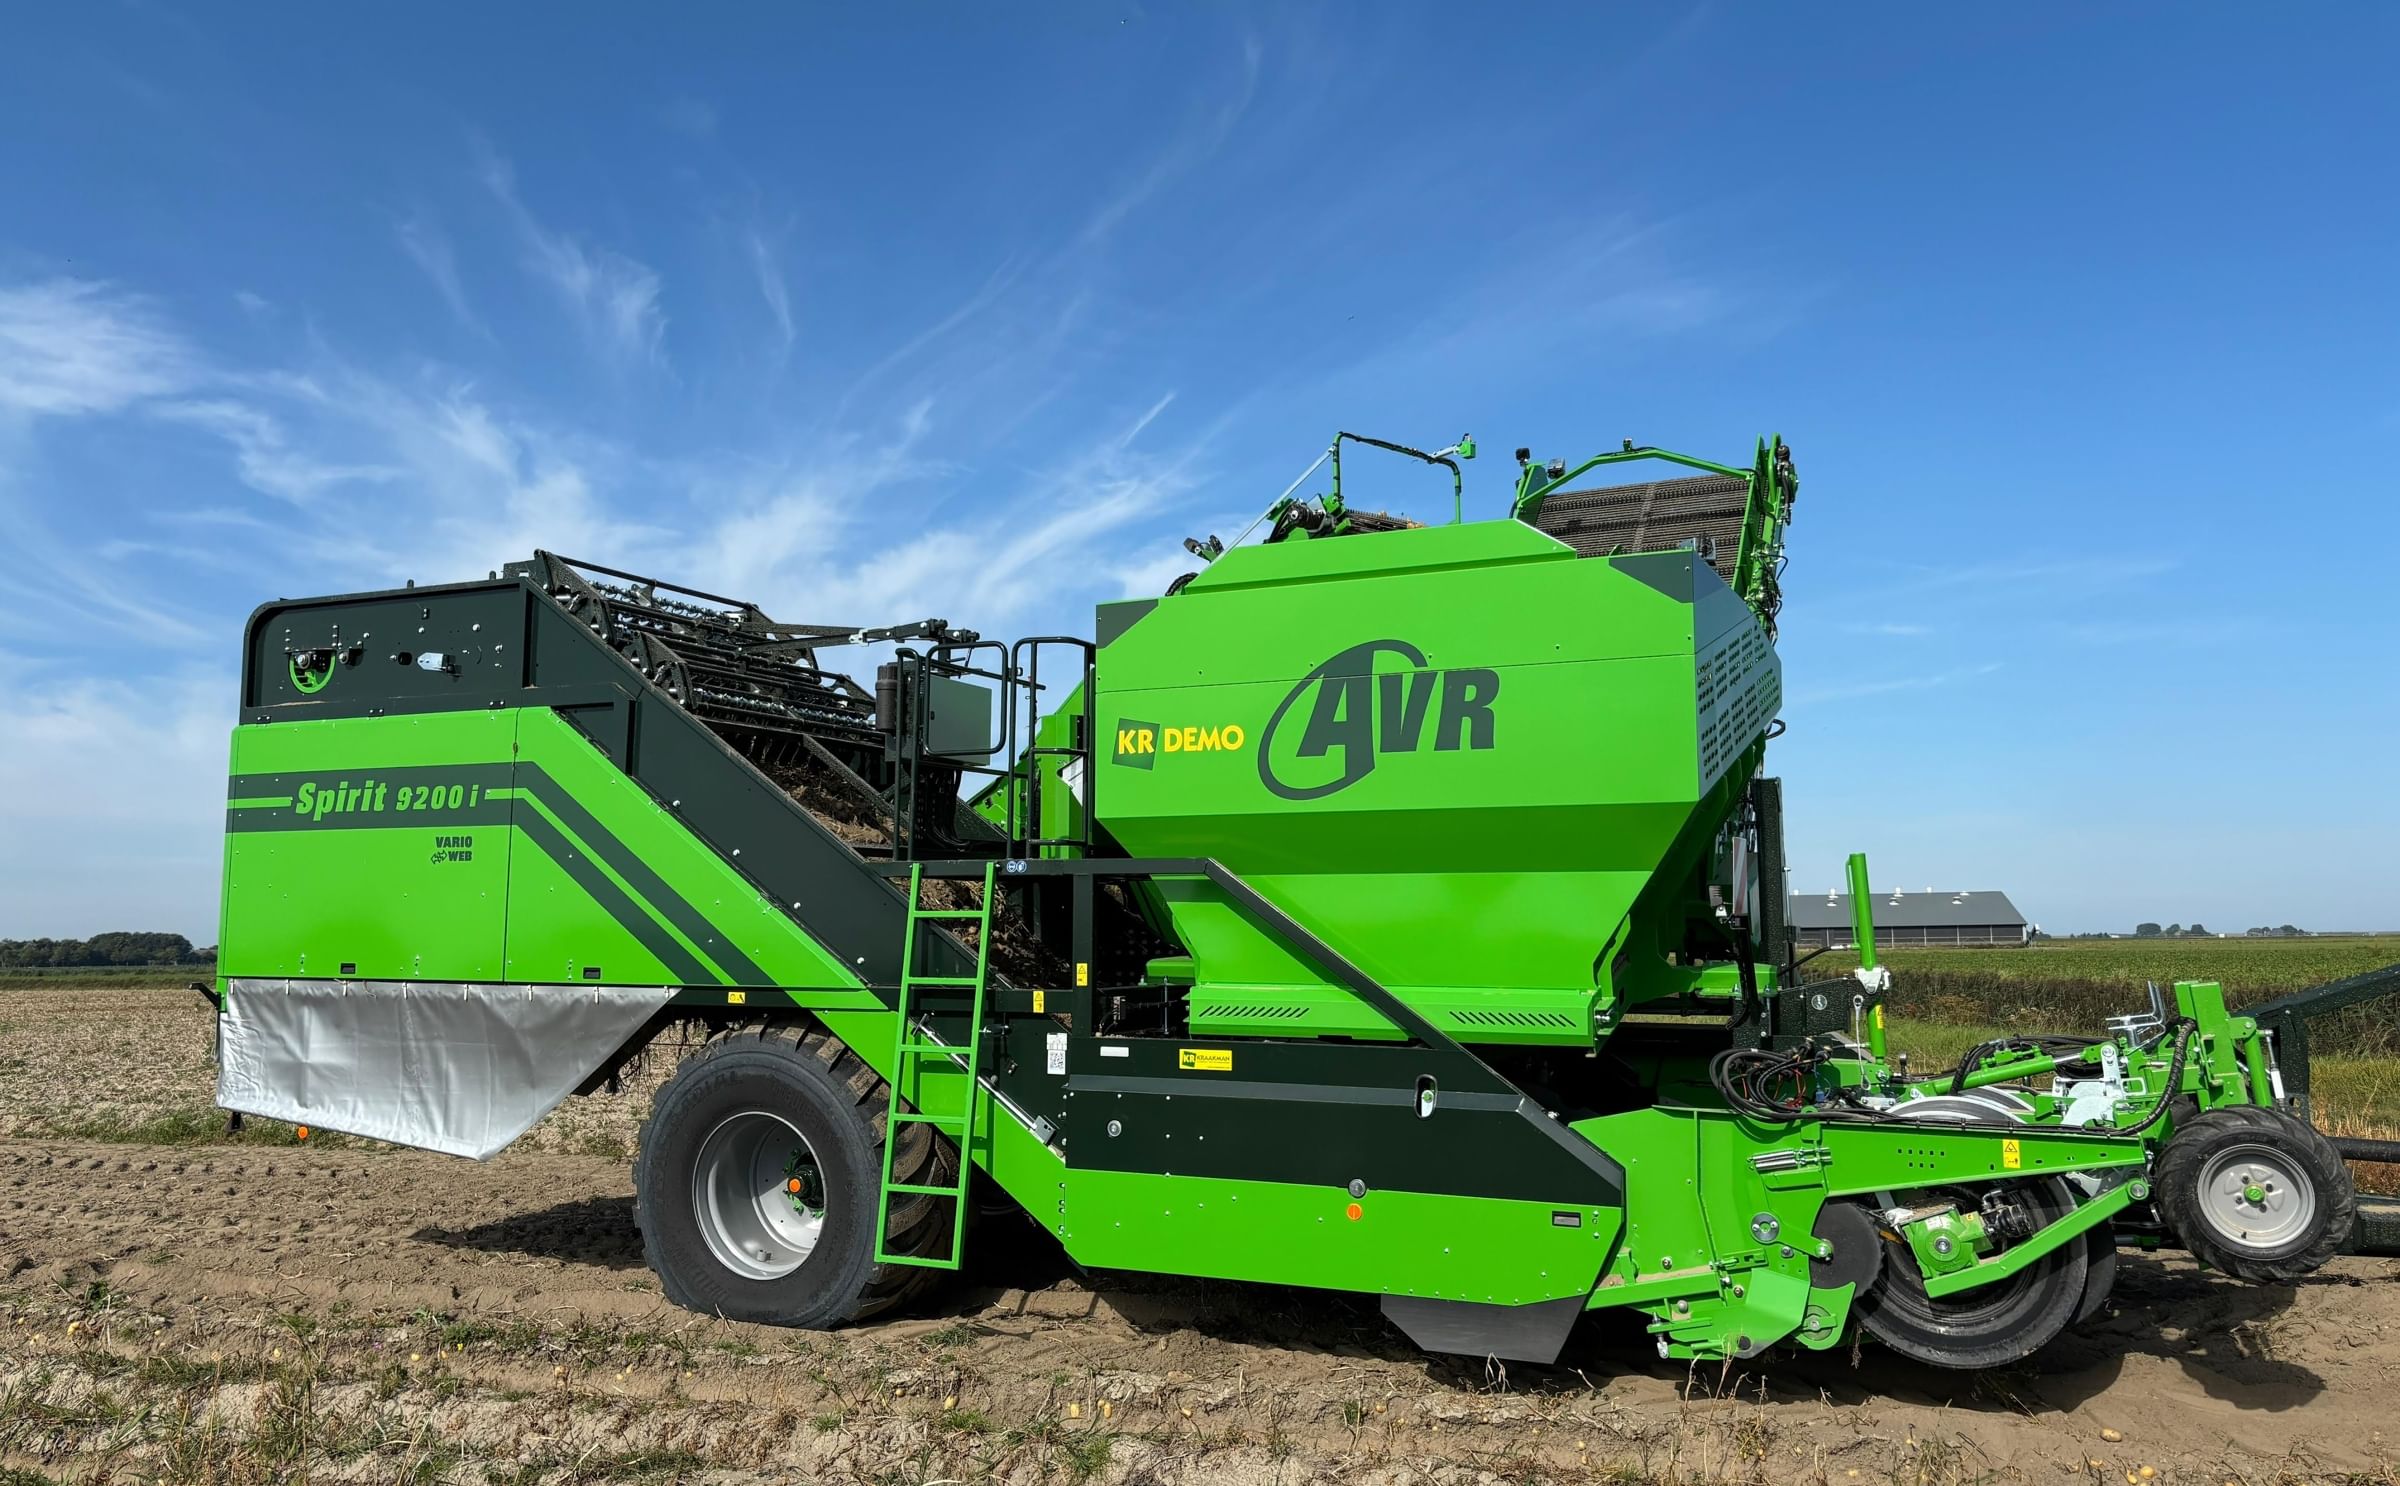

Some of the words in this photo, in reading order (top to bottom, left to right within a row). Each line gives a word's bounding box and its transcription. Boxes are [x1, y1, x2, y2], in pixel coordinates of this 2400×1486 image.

[1257, 639, 1500, 801] AVR
[1118, 729, 1155, 755] KR
[1164, 725, 1245, 752] DEMO
[295, 780, 388, 821] Spirit
[395, 785, 464, 811] 9200
[469, 784, 480, 808] i
[435, 836, 473, 848] VARIO
[448, 850, 473, 862] WEB
